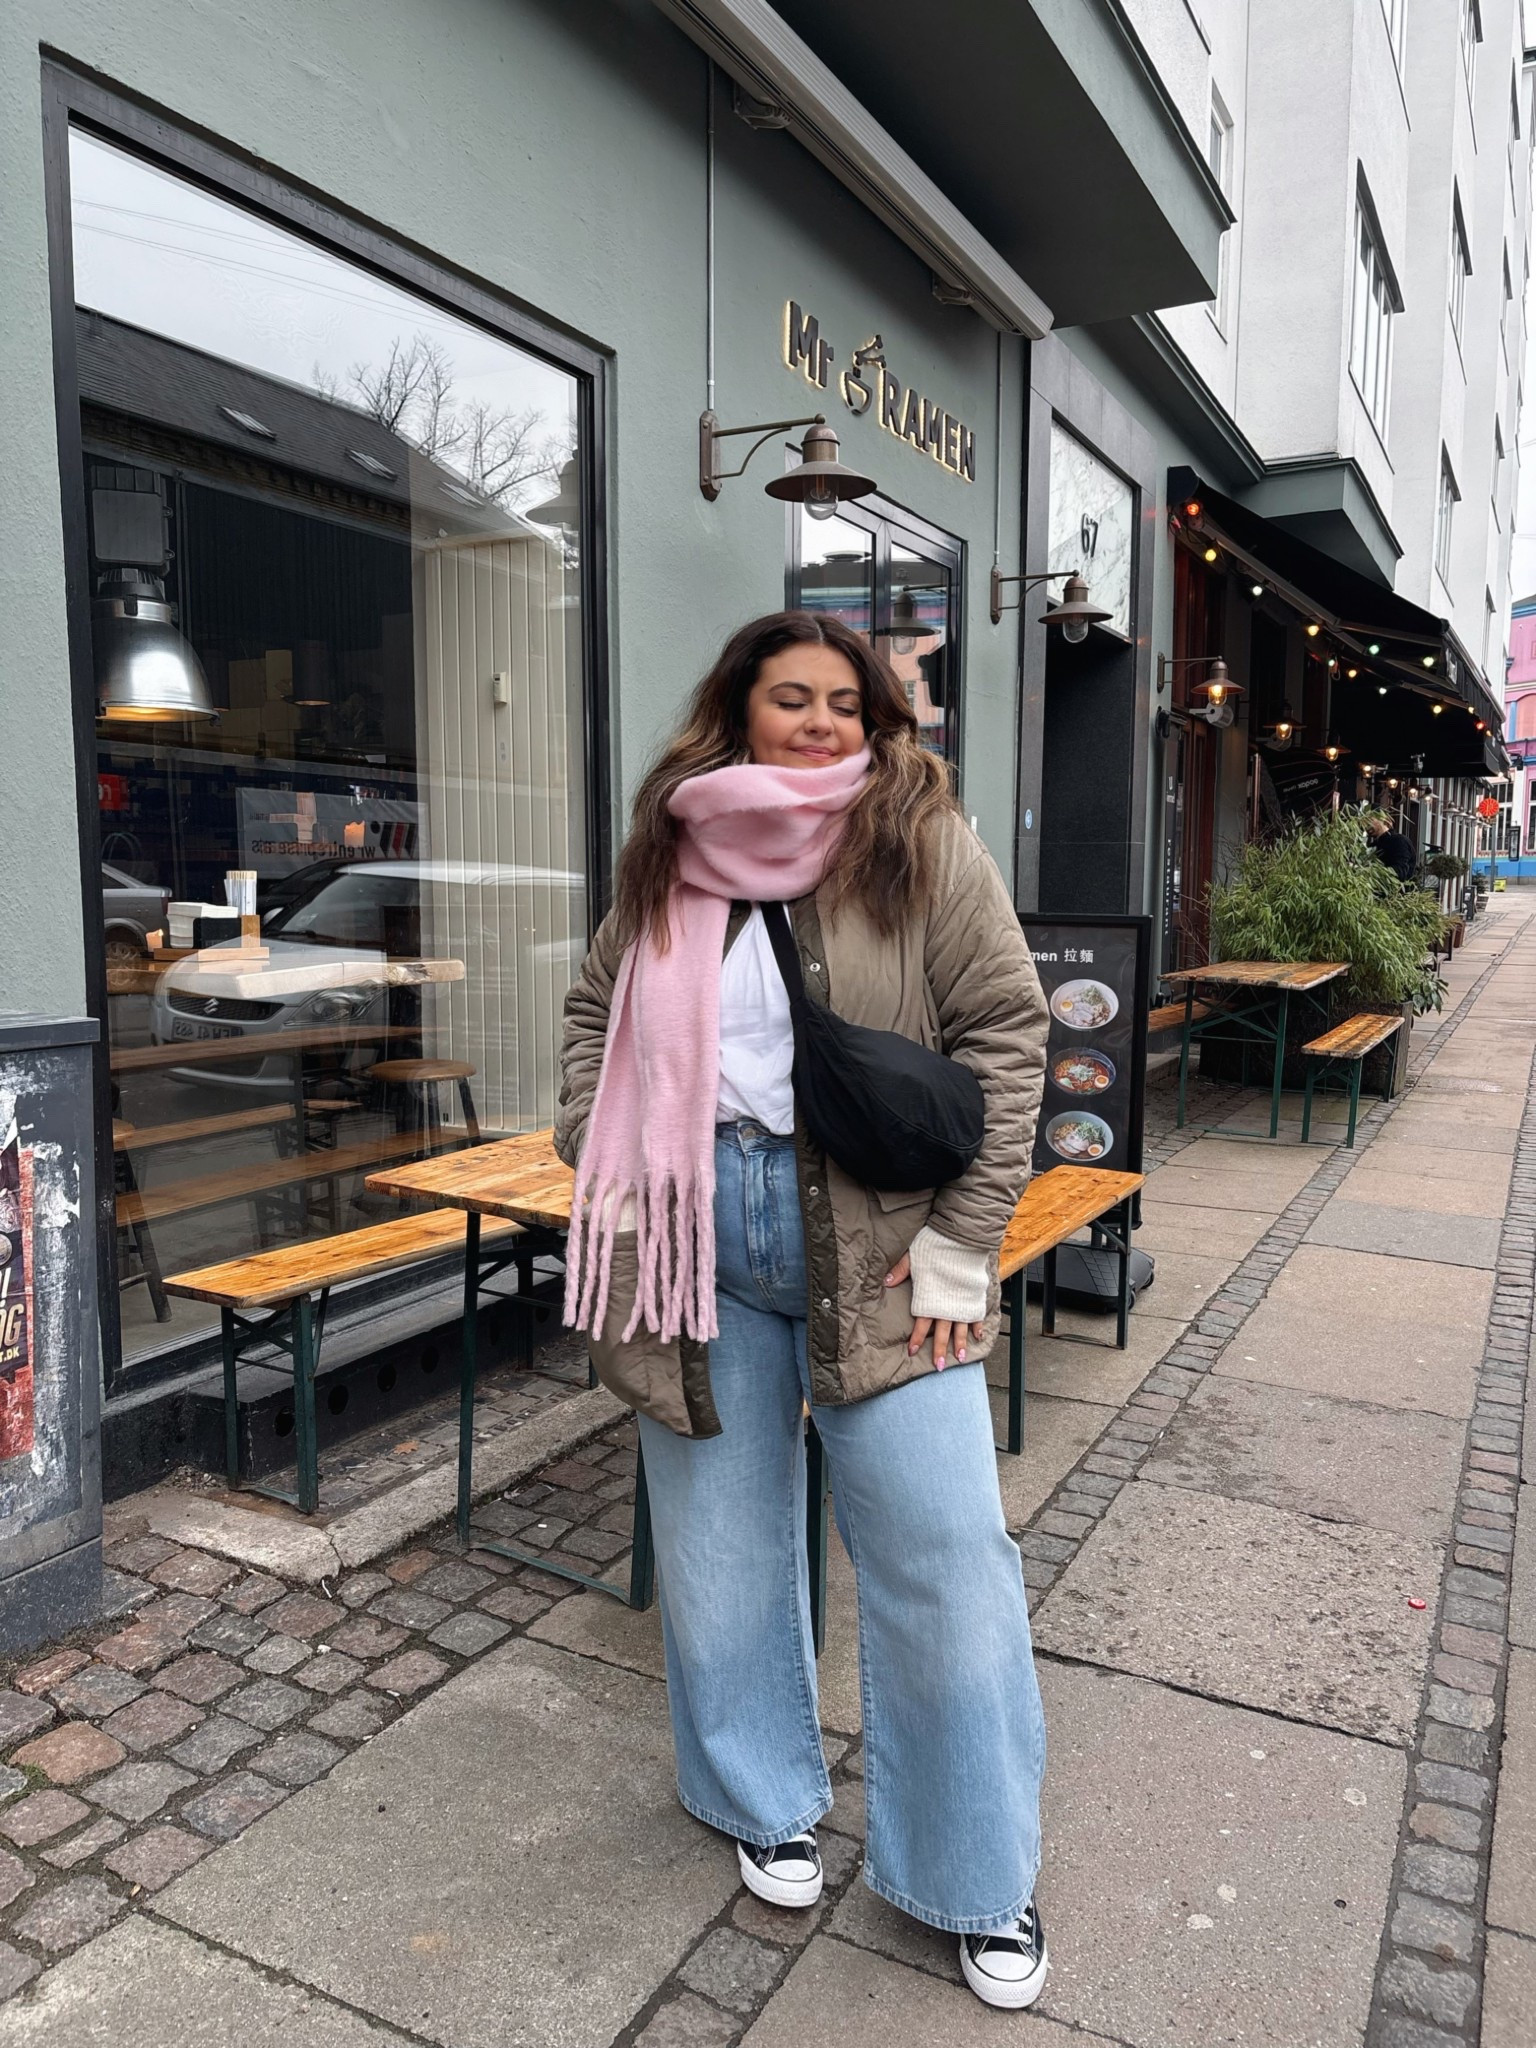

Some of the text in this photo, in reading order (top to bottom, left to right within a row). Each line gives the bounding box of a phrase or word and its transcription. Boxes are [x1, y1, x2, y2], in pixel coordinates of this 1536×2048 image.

[786, 300, 976, 482] Mr RAMEN
[1081, 512, 1099, 558] 67
[1030, 951, 1058, 962] men
